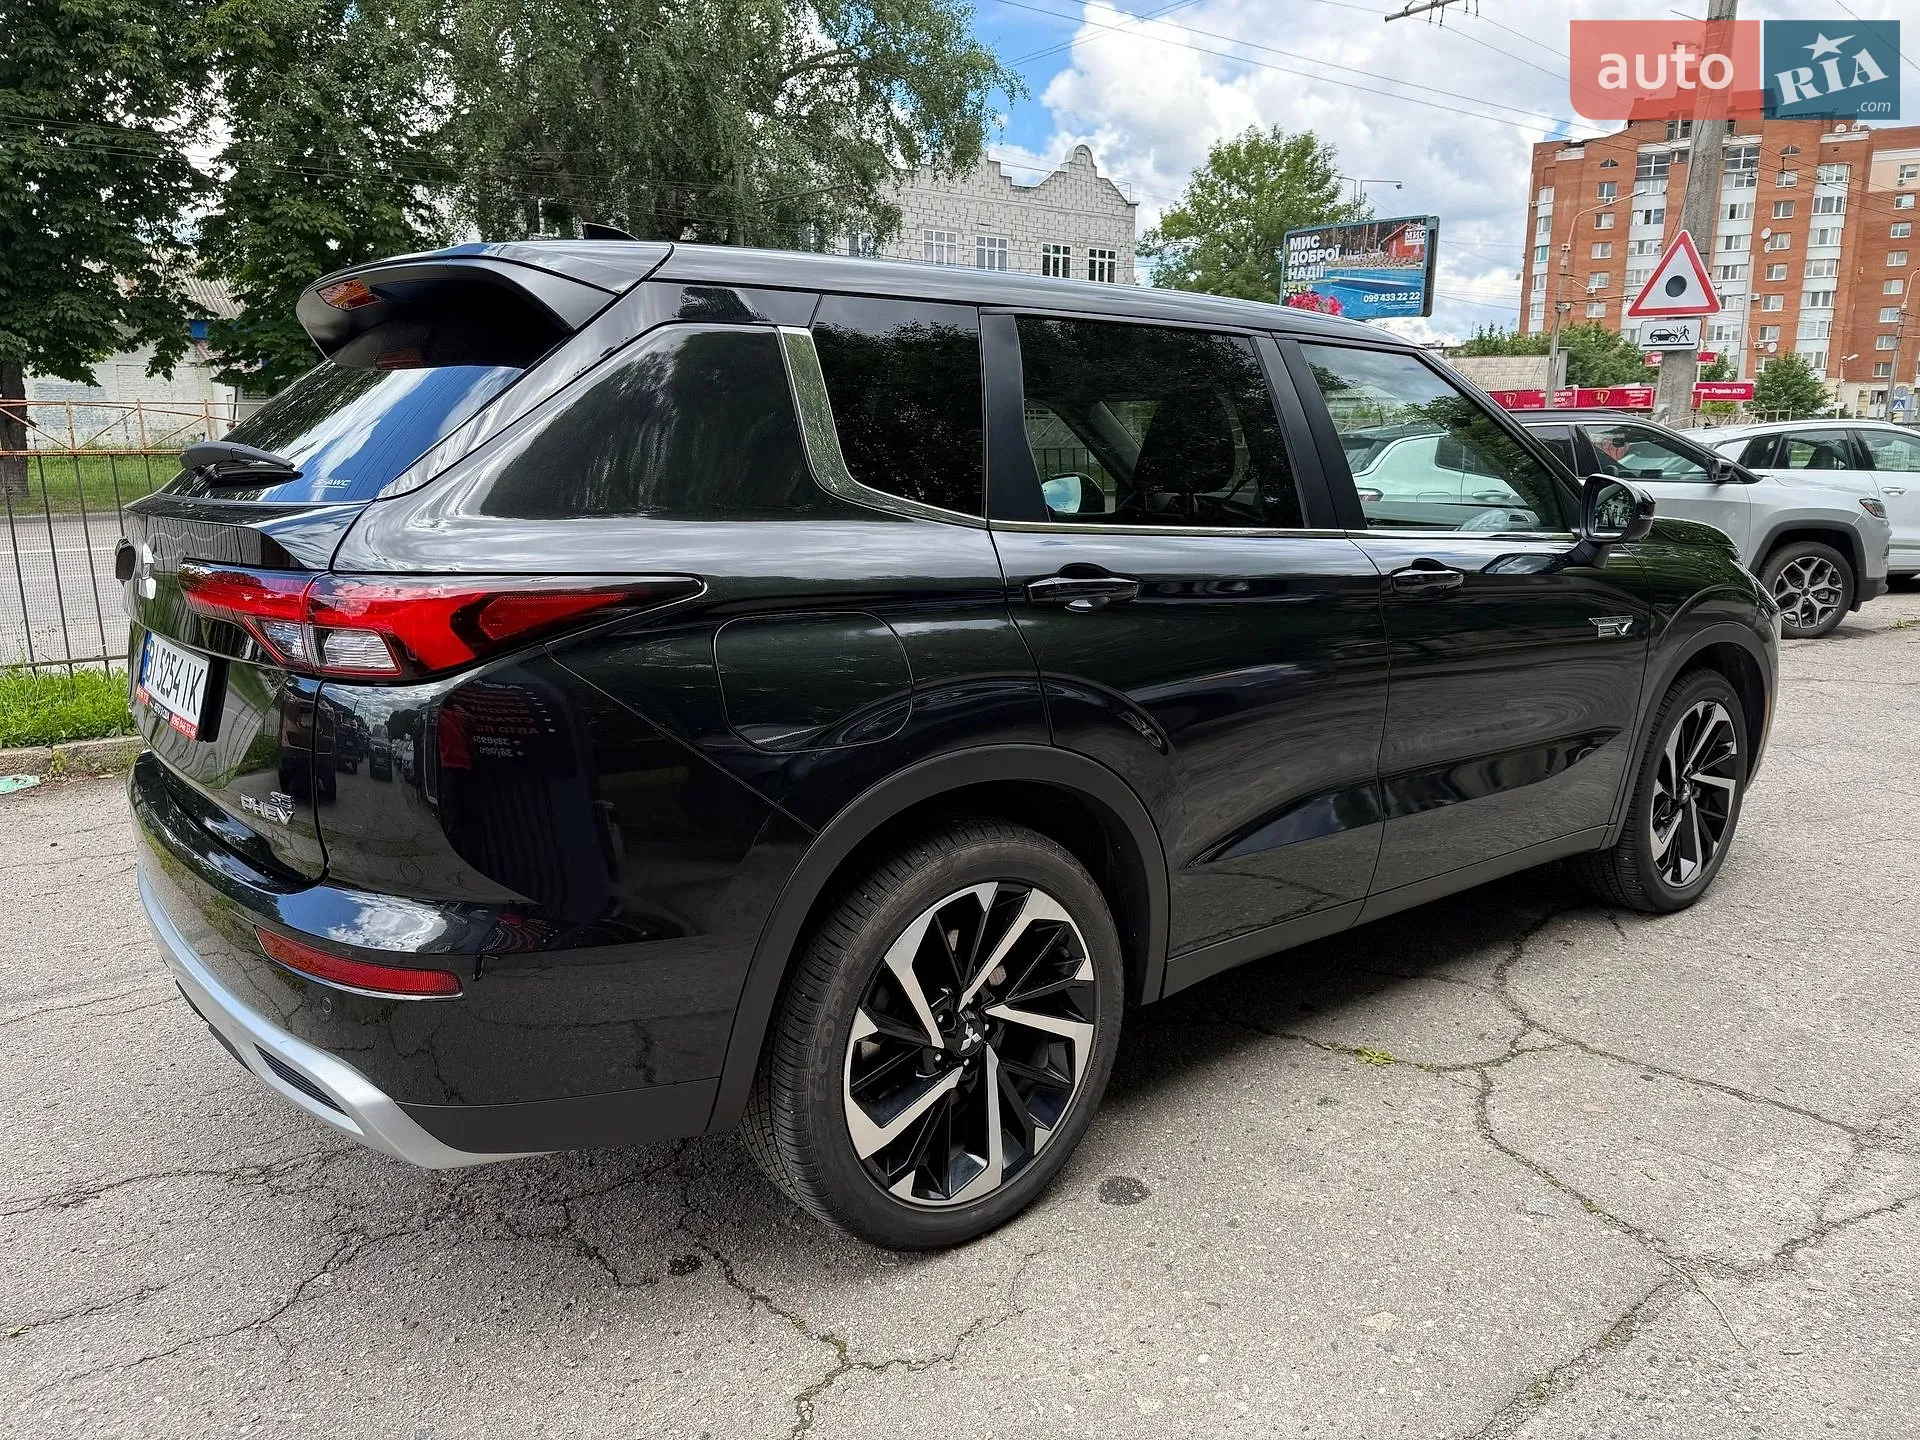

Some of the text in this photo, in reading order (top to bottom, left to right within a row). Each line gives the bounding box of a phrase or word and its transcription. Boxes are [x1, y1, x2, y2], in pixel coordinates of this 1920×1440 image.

[1290, 235, 1320, 251] МИС
[1405, 231, 1426, 240] МИС
[1288, 245, 1341, 266] ДОБРОЇ
[1288, 261, 1325, 280] НАДІЇ
[1363, 291, 1420, 303] 099 433 22 22
[156, 647, 184, 704] 5254
[240, 793, 294, 825] PHEV
